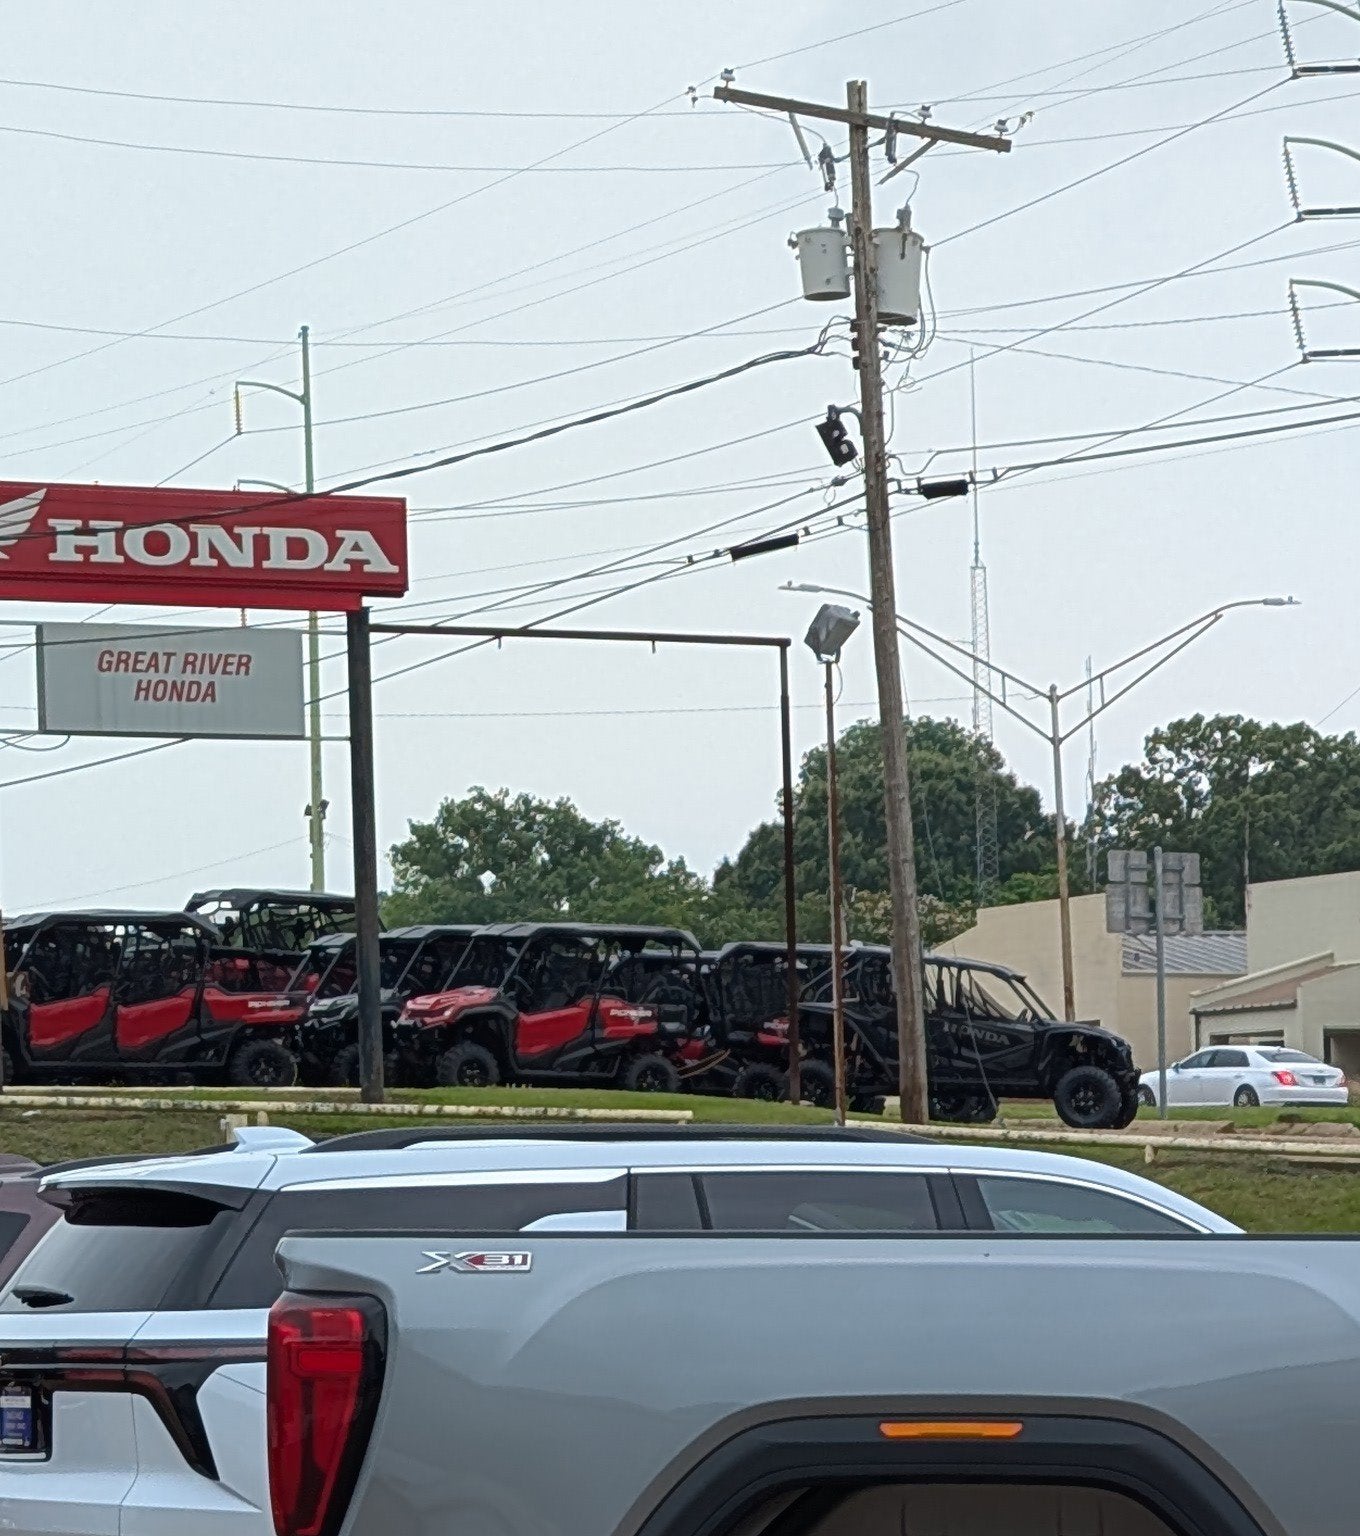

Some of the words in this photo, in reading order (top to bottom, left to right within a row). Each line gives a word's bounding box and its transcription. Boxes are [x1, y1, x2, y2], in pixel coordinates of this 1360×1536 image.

[47, 518, 399, 574] HONDA
[97, 649, 177, 675] GREAT
[181, 652, 253, 677] RIVER
[133, 678, 218, 703] HONDA
